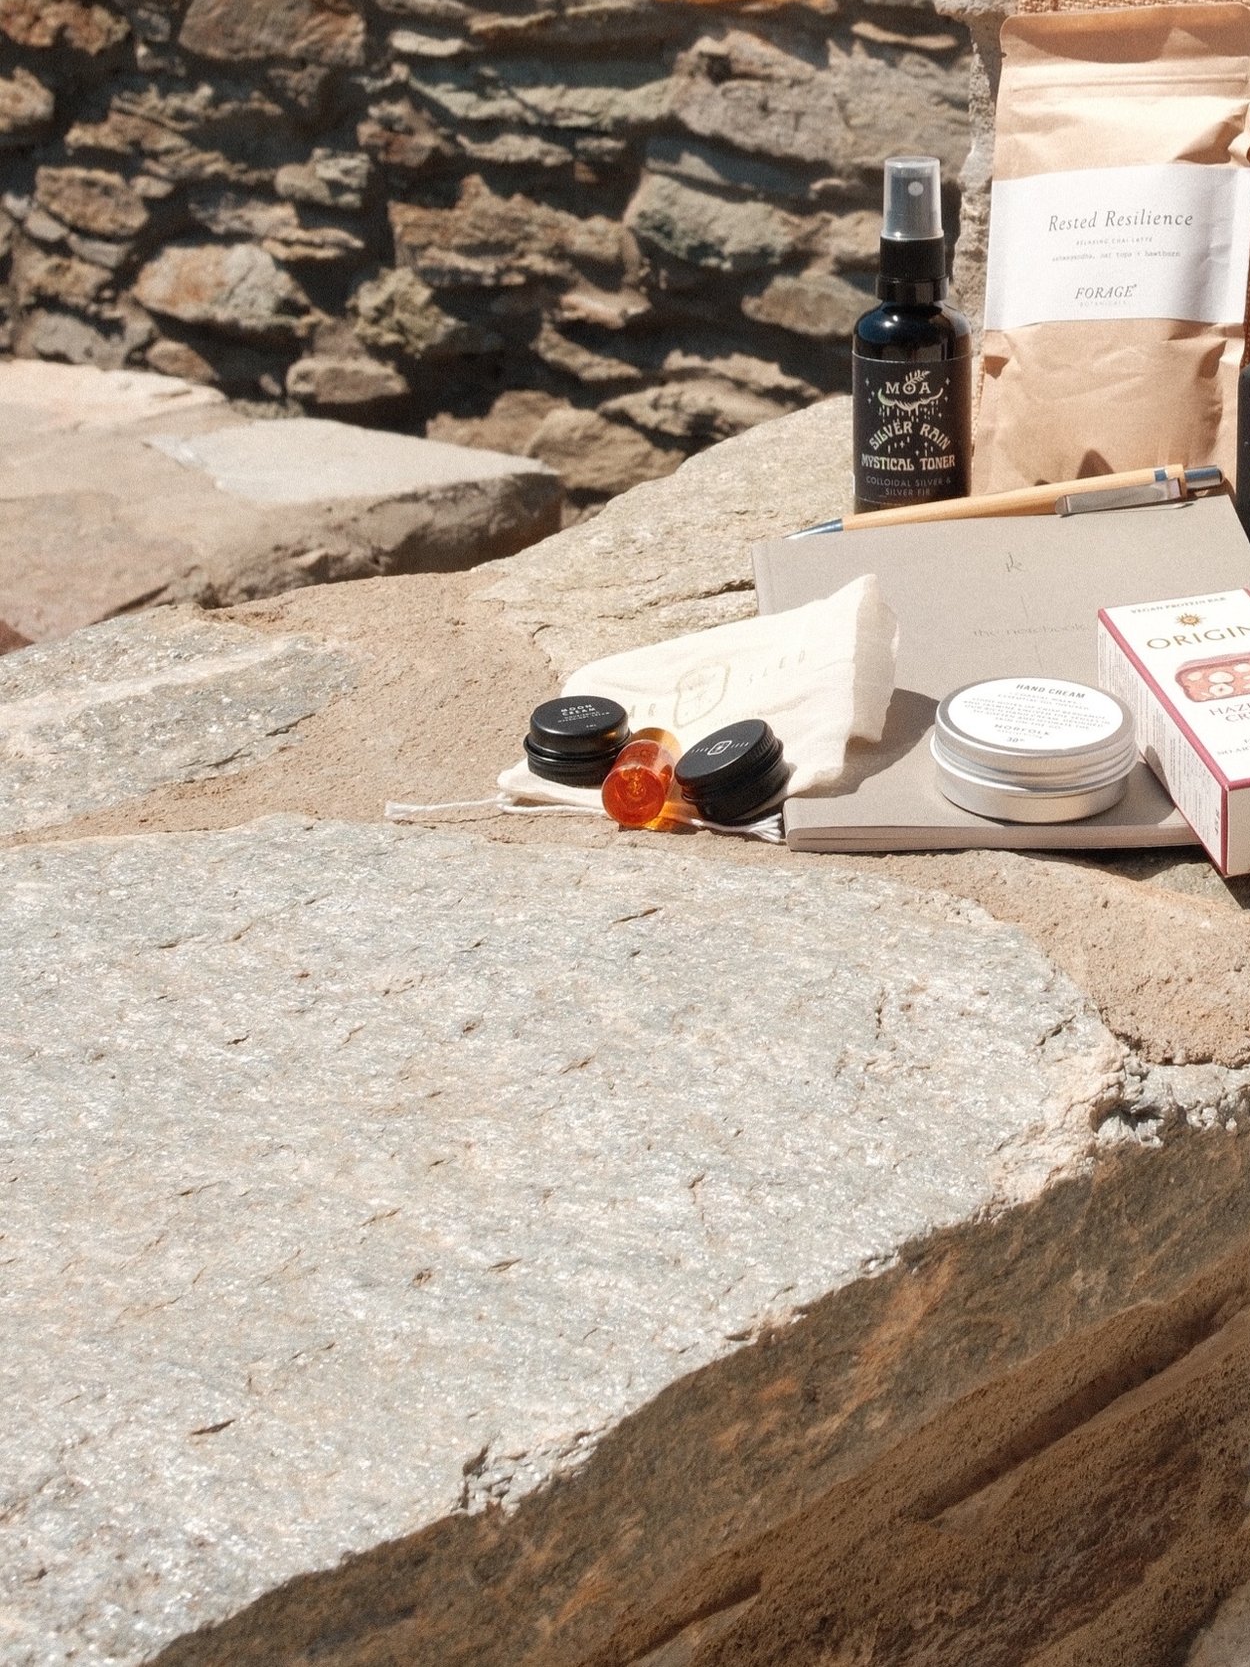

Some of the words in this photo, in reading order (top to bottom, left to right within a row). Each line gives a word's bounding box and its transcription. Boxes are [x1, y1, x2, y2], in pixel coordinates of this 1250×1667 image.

[1049, 211, 1098, 232] Rested
[1105, 208, 1194, 227] Resilience
[869, 420, 913, 450] SILVER
[920, 423, 951, 450] RAIN
[861, 453, 915, 471] MYSTICAL
[920, 454, 956, 471] TONER
[866, 475, 911, 487] COLLOIDAL
[915, 478, 942, 487] SILVER
[885, 487, 913, 496] SILVER
[917, 488, 931, 496] FIR
[1131, 604, 1163, 614] VEGAN
[1165, 599, 1206, 610] PROTEIN
[1207, 596, 1227, 604] BAR
[1016, 683, 1046, 693] HAND
[1049, 688, 1086, 699] CREAM
[994, 724, 1050, 736] NORFOLK
